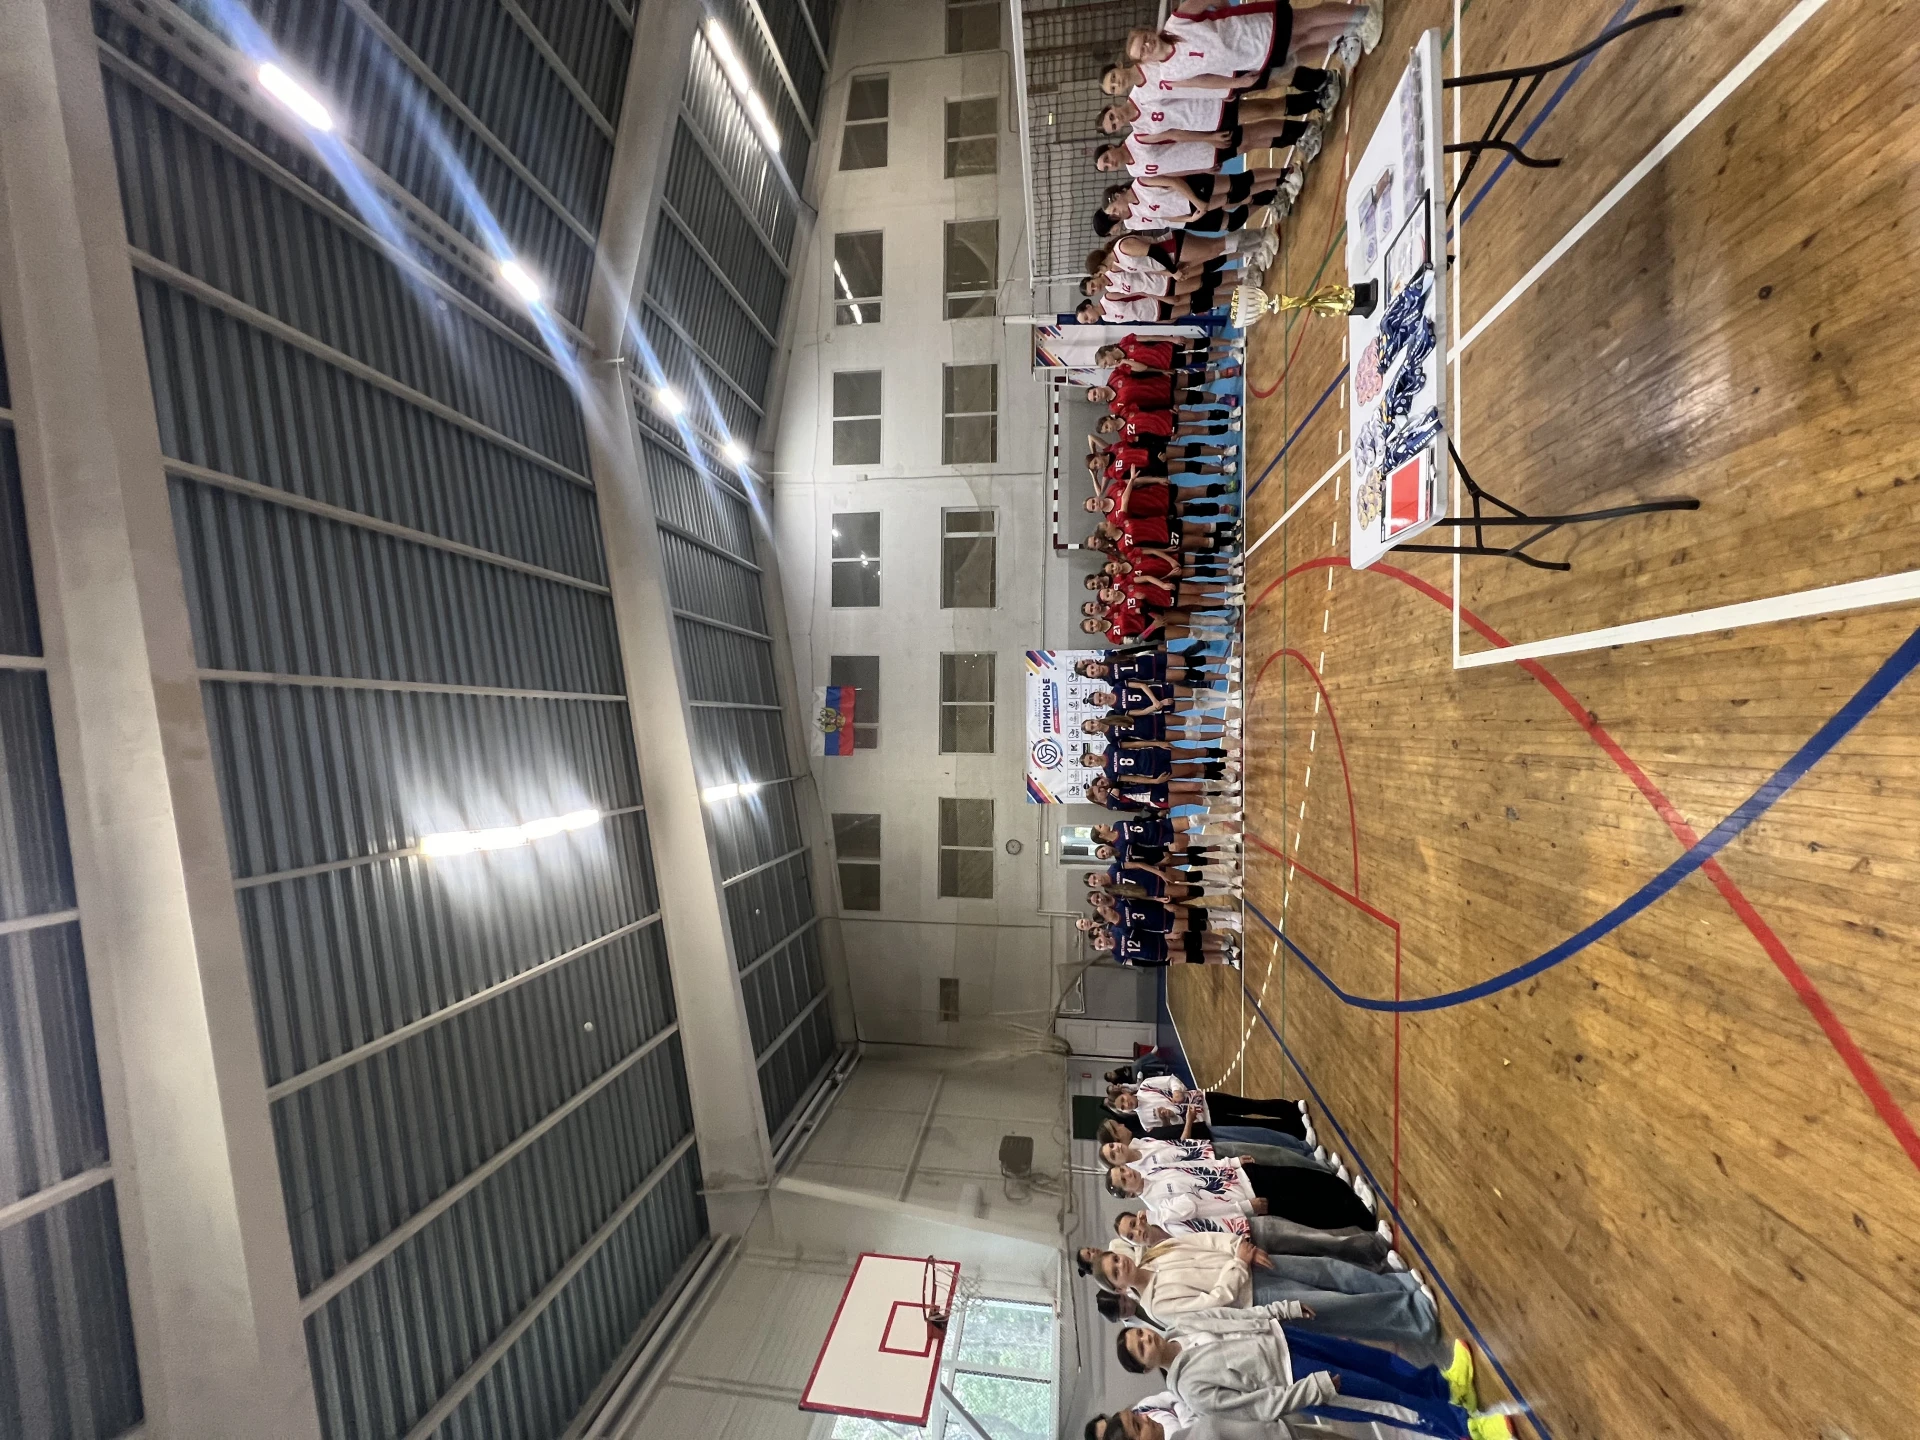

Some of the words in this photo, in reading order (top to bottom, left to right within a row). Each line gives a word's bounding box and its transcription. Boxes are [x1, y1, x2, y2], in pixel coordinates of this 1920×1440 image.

[1151, 112, 1164, 122] 8
[1145, 165, 1158, 174] 10
[1122, 283, 1130, 292] 12
[1127, 424, 1135, 435] 22
[1116, 460, 1123, 471] 16
[1125, 534, 1133, 546] 27
[1171, 532, 1179, 545] 27
[1127, 598, 1135, 609] 13
[1114, 625, 1120, 635] 21
[1042, 678, 1050, 733] ПРИМОРЬЕ
[1120, 758, 1134, 766] 8
[1132, 912, 1145, 920] 3
[1127, 940, 1140, 953] 12
